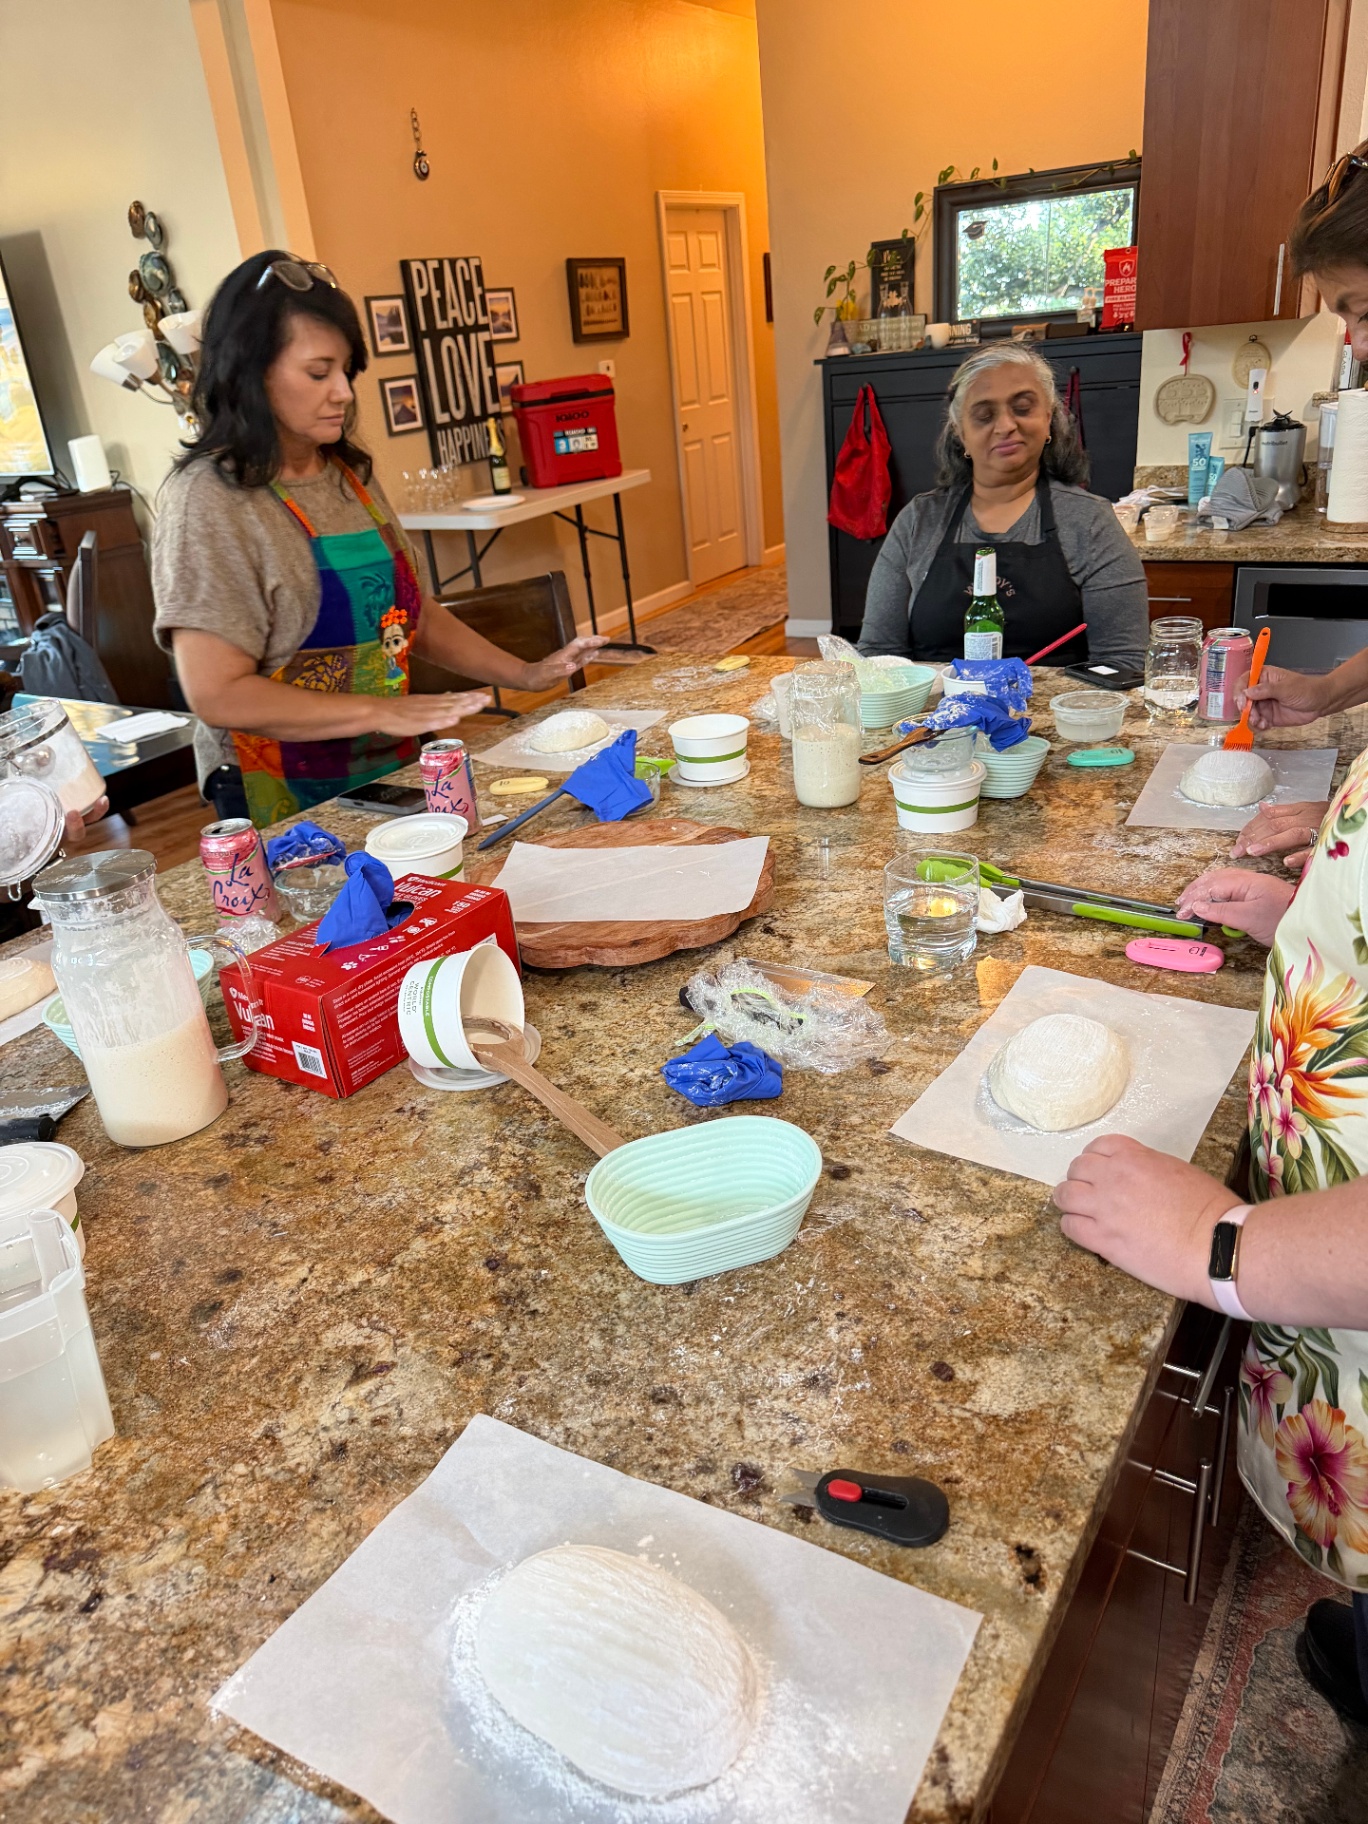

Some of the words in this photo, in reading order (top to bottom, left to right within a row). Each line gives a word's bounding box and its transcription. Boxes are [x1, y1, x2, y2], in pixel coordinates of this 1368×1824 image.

[410, 258, 488, 331] PEACE
[1105, 277, 1137, 287] PREPAR
[1113, 285, 1137, 294] HERO
[423, 331, 501, 424] LOVE
[437, 418, 507, 468] HAPPINES
[1192, 457, 1207, 467] 50
[432, 769, 455, 799] La
[225, 852, 255, 887] La
[213, 880, 271, 912] Croix
[394, 881, 443, 899] Vulcan
[406, 980, 415, 1016] CENTRIC
[411, 982, 420, 1013] WORLD
[233, 1000, 275, 1031] Vulan
